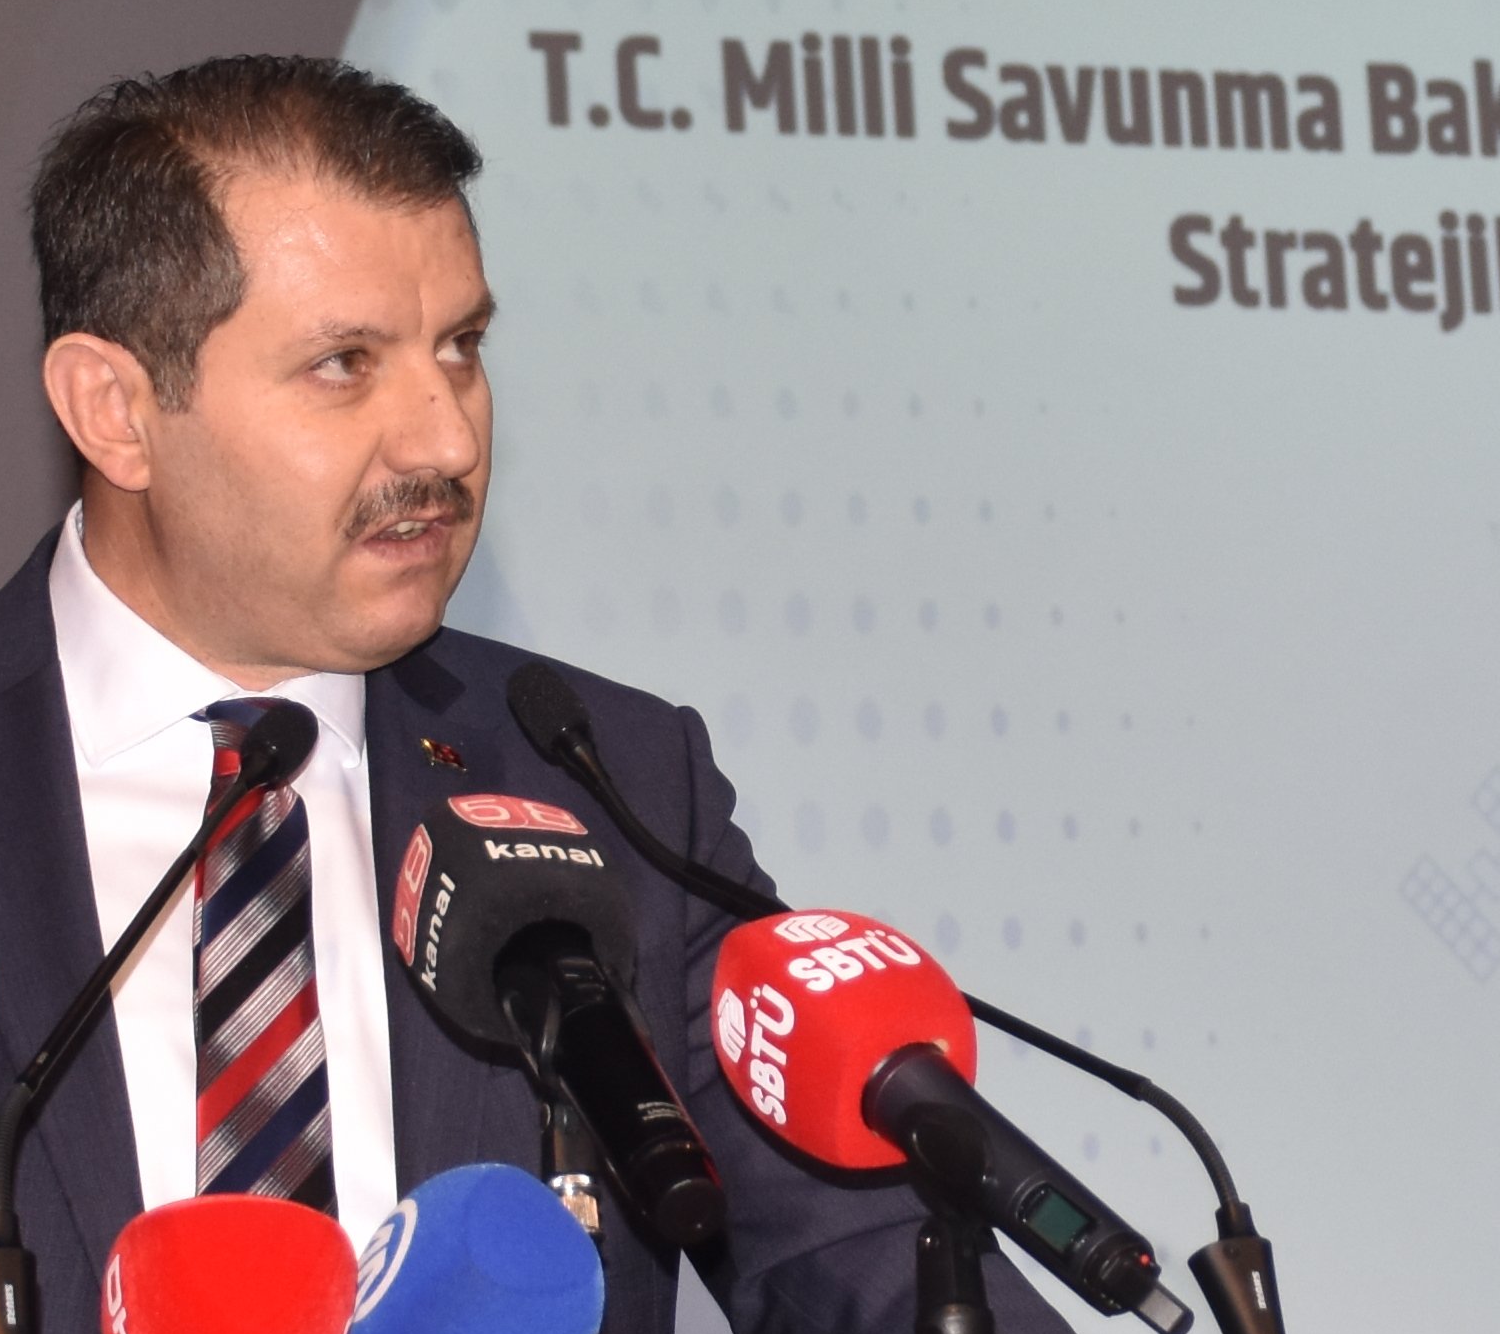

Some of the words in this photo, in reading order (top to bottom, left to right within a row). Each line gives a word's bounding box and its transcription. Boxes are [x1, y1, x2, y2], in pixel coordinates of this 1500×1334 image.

[528, 30, 693, 131] T.C.
[721, 32, 916, 139] Milli
[942, 47, 1344, 154] Savunma
[484, 839, 605, 868] kanal
[421, 871, 457, 992] kanal
[787, 929, 922, 993] SBTÜ
[749, 983, 796, 1126] SBTÜ
